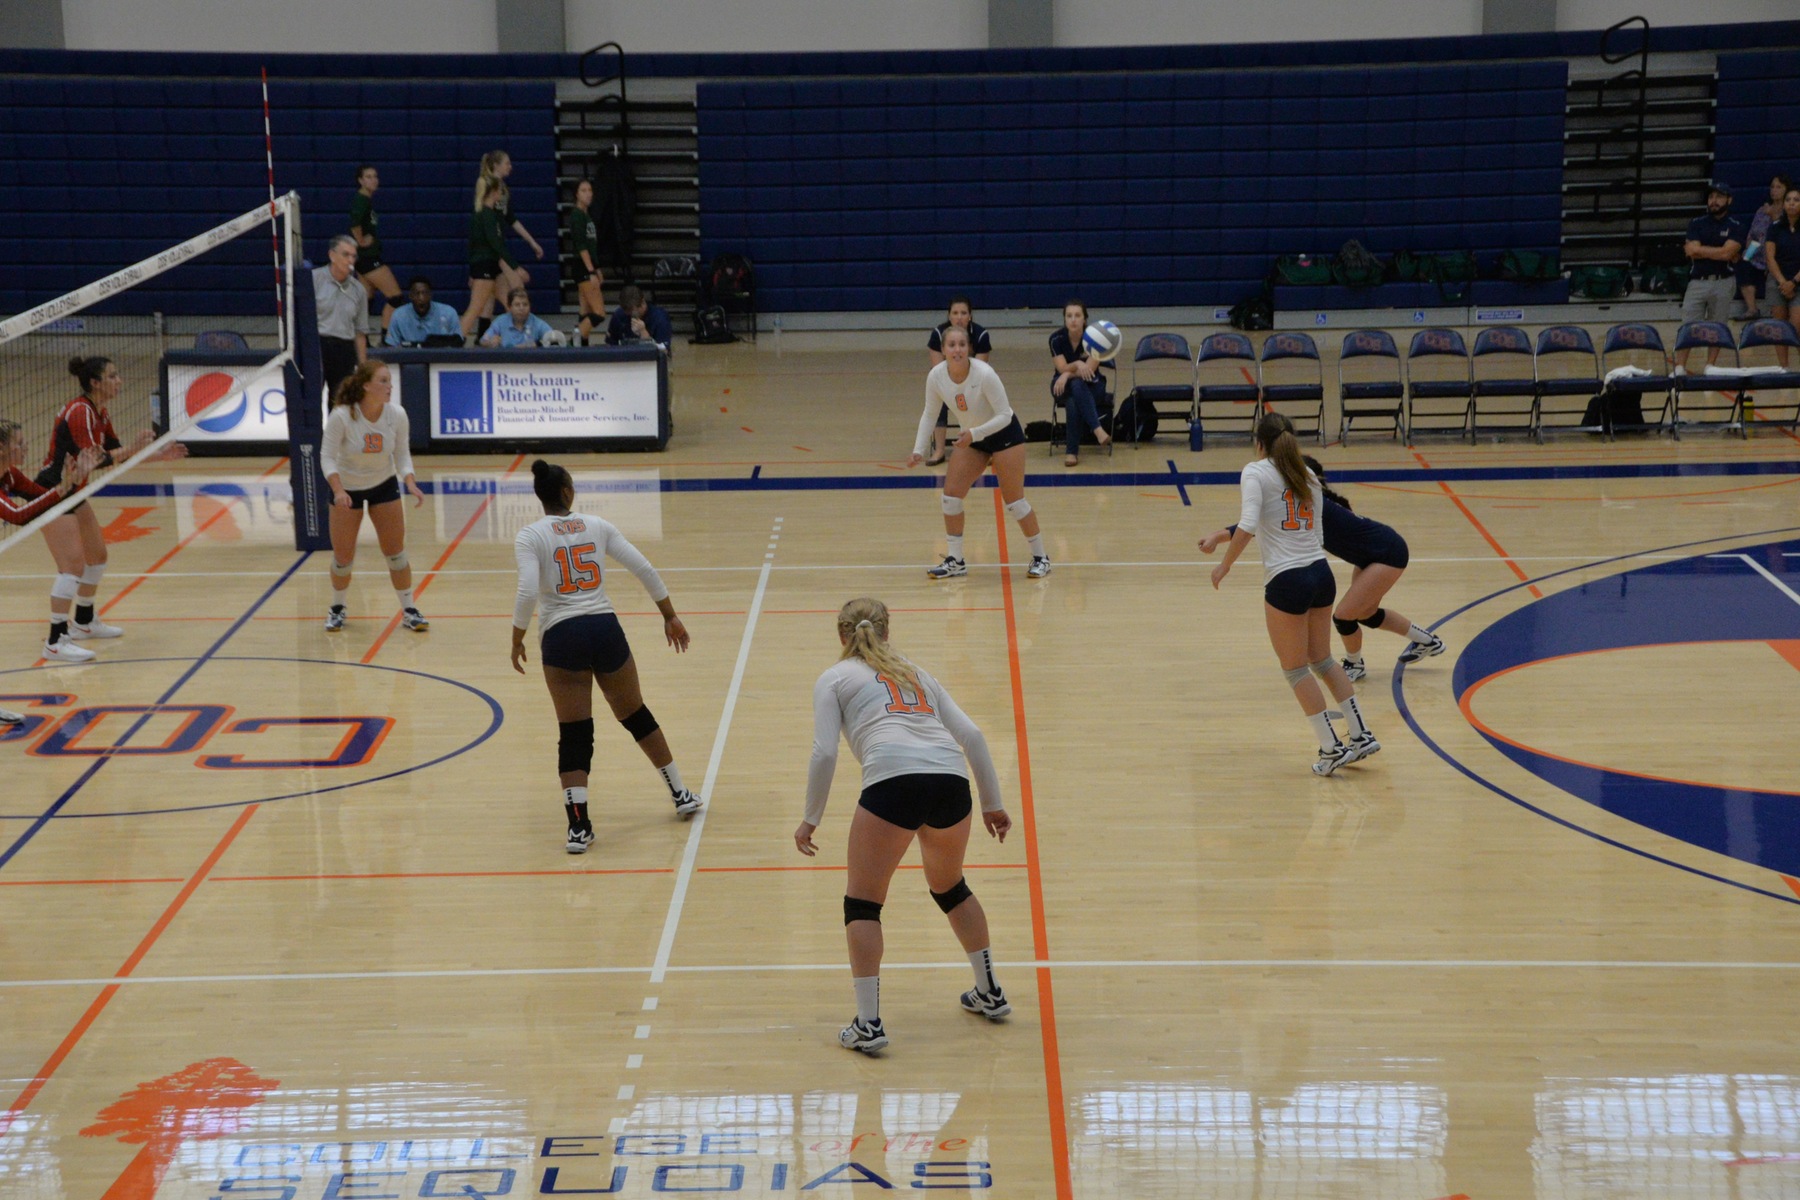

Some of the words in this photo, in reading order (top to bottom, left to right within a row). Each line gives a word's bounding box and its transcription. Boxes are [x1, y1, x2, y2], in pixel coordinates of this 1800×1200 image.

[497, 373, 580, 387] Buckman-
[497, 388, 568, 403] Mitchell,
[573, 388, 605, 401] Inc.
[955, 393, 968, 412] 8
[497, 405, 575, 414] Buckman-Mitchell
[497, 414, 536, 423] Financial
[538, 415, 546, 423] &
[548, 414, 590, 423] Insurance
[633, 413, 650, 421] Inc.
[362, 432, 384, 454] 19
[1281, 487, 1314, 531] 14
[551, 518, 587, 536] COS
[553, 542, 602, 594] 15
[875, 669, 936, 716] 11
[233, 1133, 760, 1167] COLLEGE
[809, 1132, 877, 1156] of
[882, 1132, 968, 1153] the
[208, 1161, 993, 1200] SEQUOIAS
